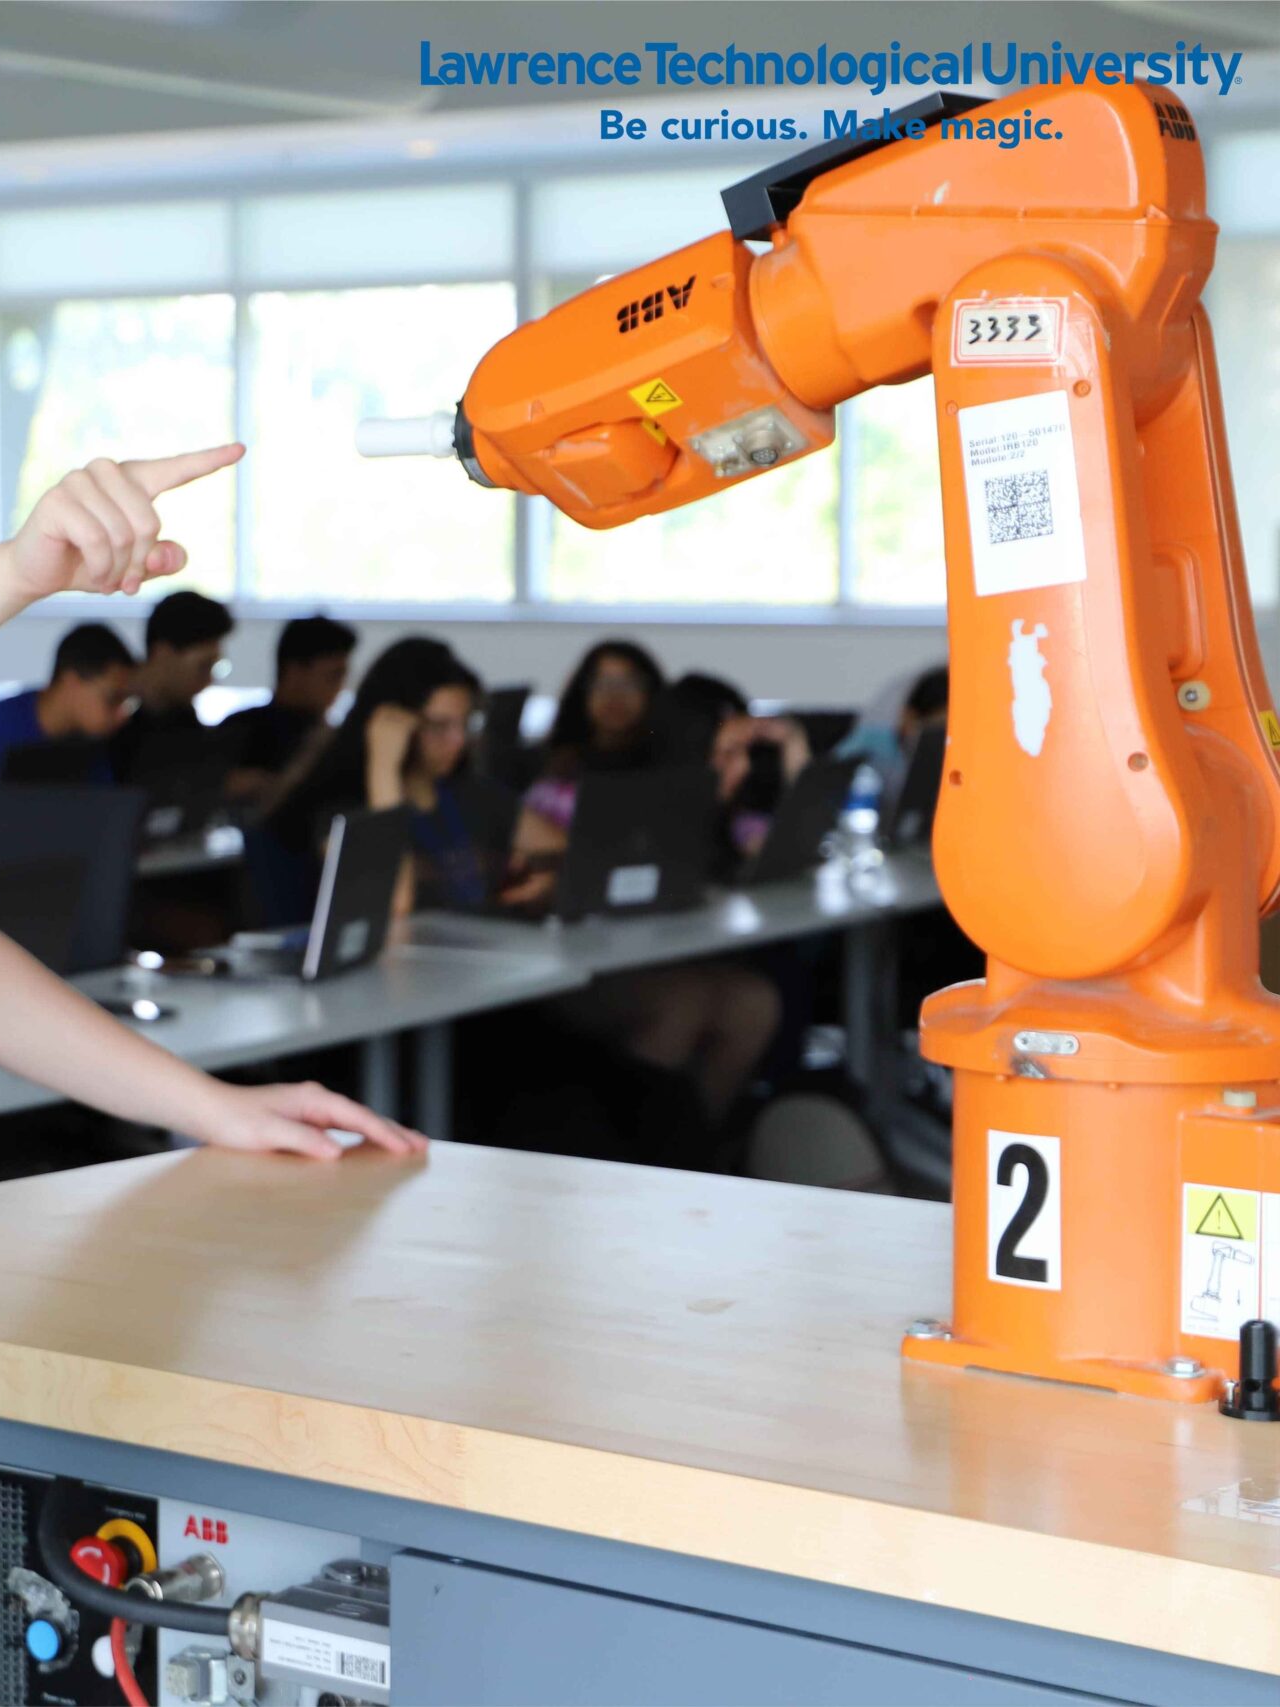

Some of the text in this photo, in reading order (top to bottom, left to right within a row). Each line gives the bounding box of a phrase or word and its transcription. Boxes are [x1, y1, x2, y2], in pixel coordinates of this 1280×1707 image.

[616, 274, 696, 333] ABB
[995, 1143, 1049, 1283] 2
[184, 1514, 229, 1544] ABB
